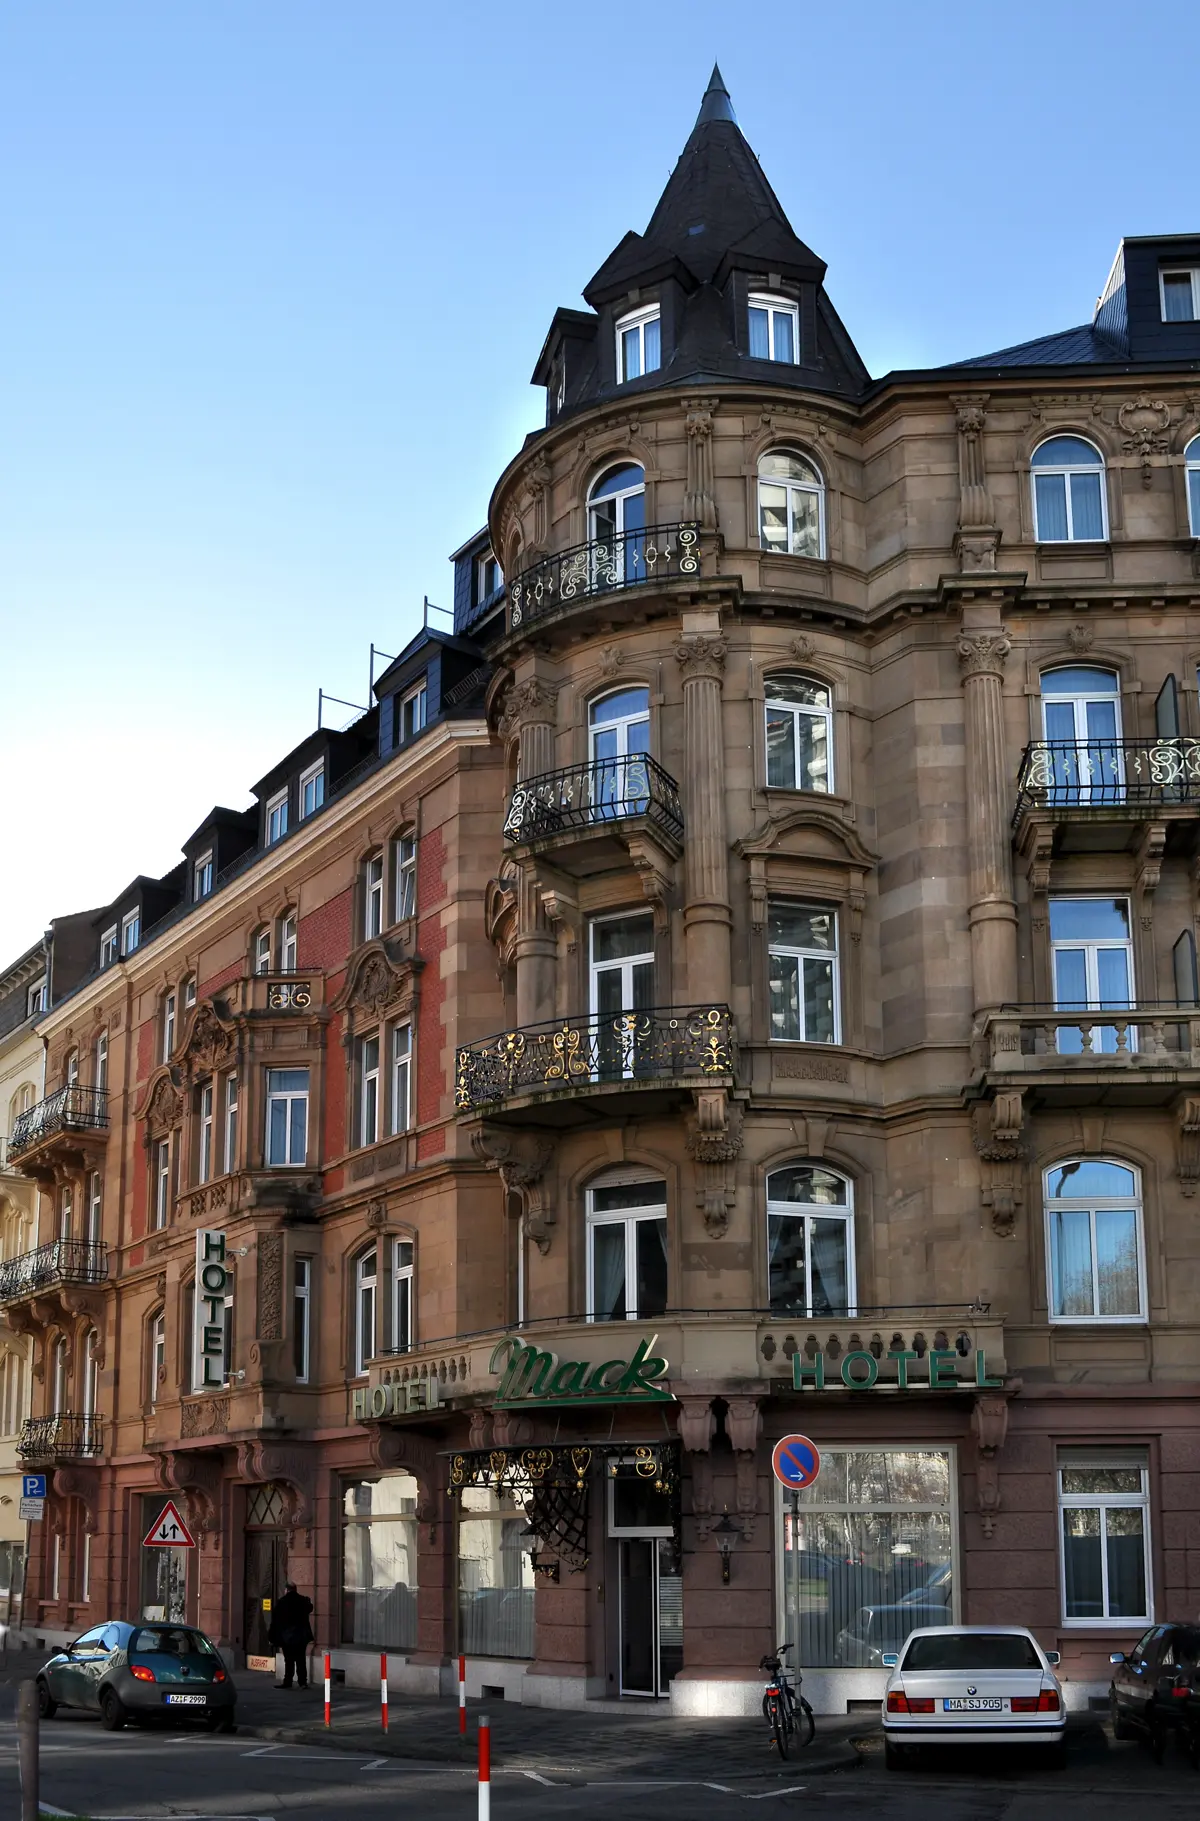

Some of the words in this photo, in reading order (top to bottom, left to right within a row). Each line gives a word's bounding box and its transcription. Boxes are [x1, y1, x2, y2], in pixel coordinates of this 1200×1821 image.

[201, 1232, 226, 1386] HOTEL
[489, 1334, 677, 1402] Mack
[792, 1350, 1003, 1390] HOTEL
[352, 1376, 446, 1421] HOTEL
[26, 1478, 39, 1495] P
[170, 1695, 180, 1703] AZ
[190, 1695, 206, 1704] 2999
[949, 1699, 963, 1709] MA
[968, 1699, 981, 1709] SJ
[982, 1699, 1001, 1709] 905
